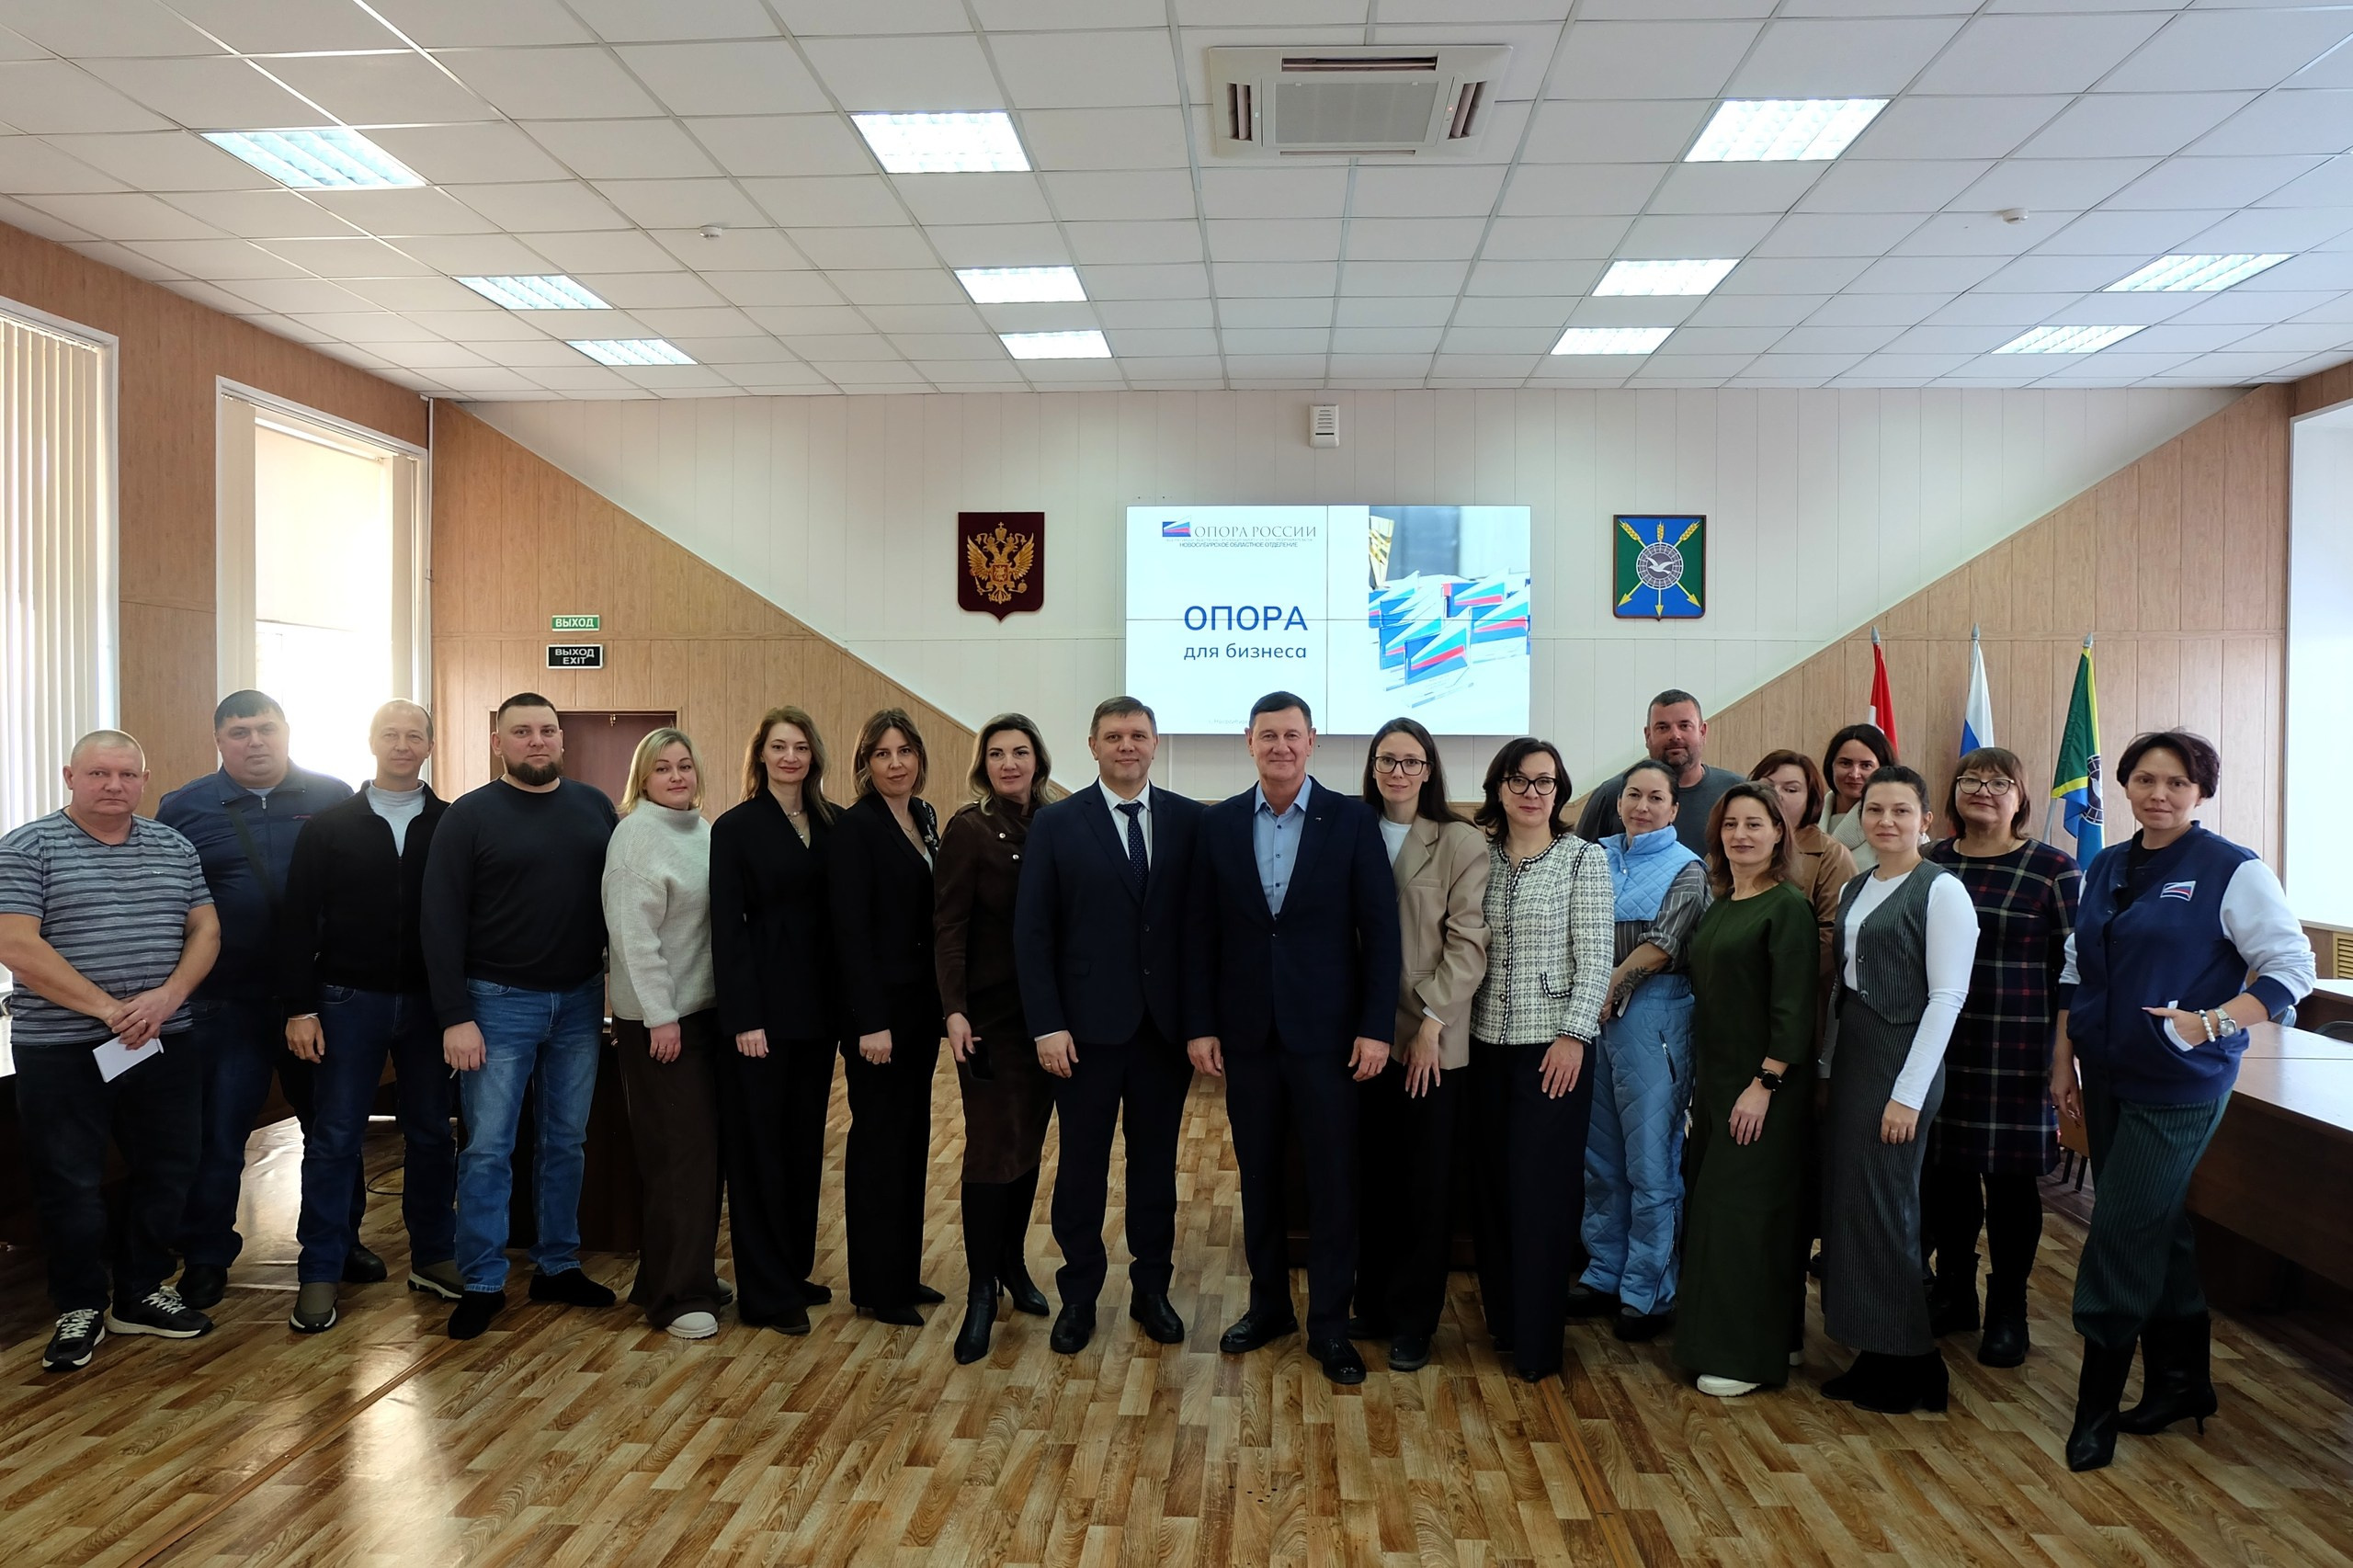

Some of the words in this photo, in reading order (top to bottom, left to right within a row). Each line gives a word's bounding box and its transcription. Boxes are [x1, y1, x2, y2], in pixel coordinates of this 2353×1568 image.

[1194, 526, 1248, 538] ОПОРА
[1252, 526, 1316, 538] РОССИИ
[555, 618, 595, 628] ВЫХОД
[1184, 605, 1308, 631] ОПОРА
[554, 648, 595, 658] ВЫХОД
[1184, 647, 1219, 660] для
[1225, 642, 1306, 658] бизнеса
